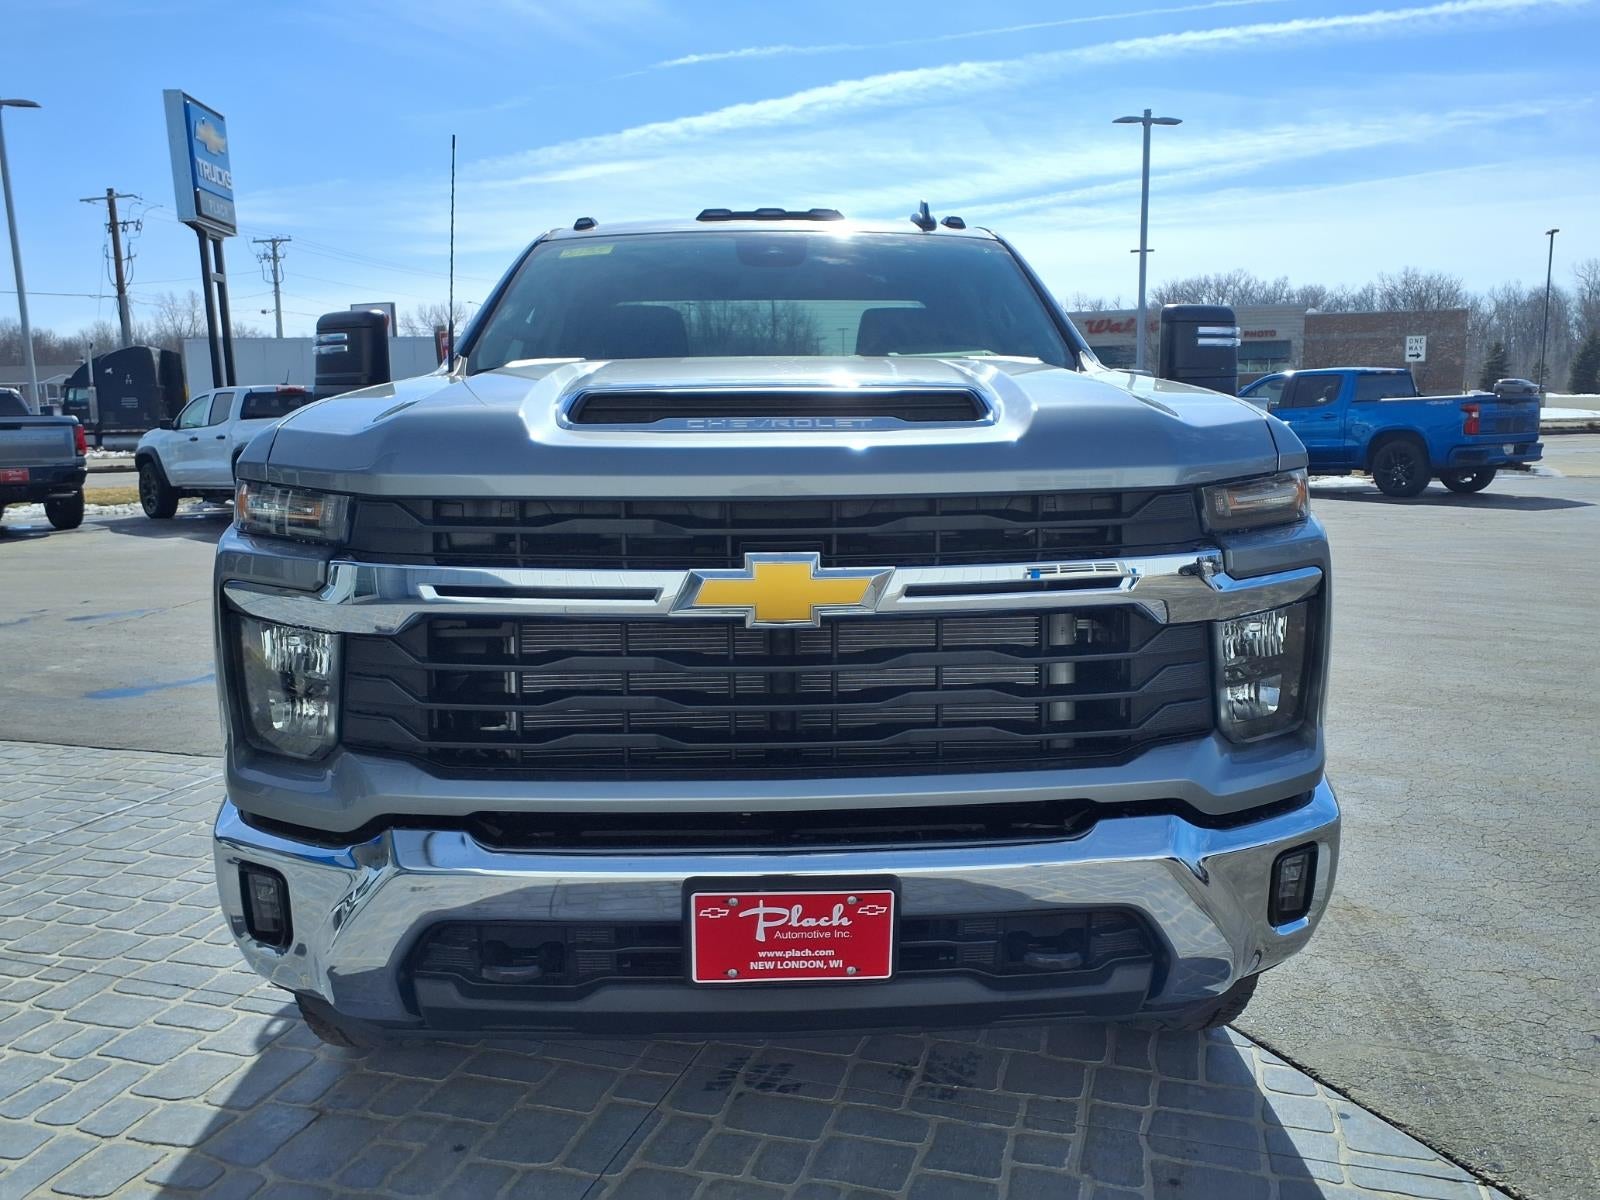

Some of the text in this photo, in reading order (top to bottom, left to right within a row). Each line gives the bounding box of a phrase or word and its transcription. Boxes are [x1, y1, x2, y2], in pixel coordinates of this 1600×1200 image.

[195, 158, 232, 190] TRUCKS
[687, 418, 872, 428] CHEVROLET
[738, 899, 852, 942] Plach
[774, 929, 853, 939] Automotive Inc.
[758, 948, 835, 958] www.plach.com
[750, 960, 843, 970] NEW LONDON, WI
